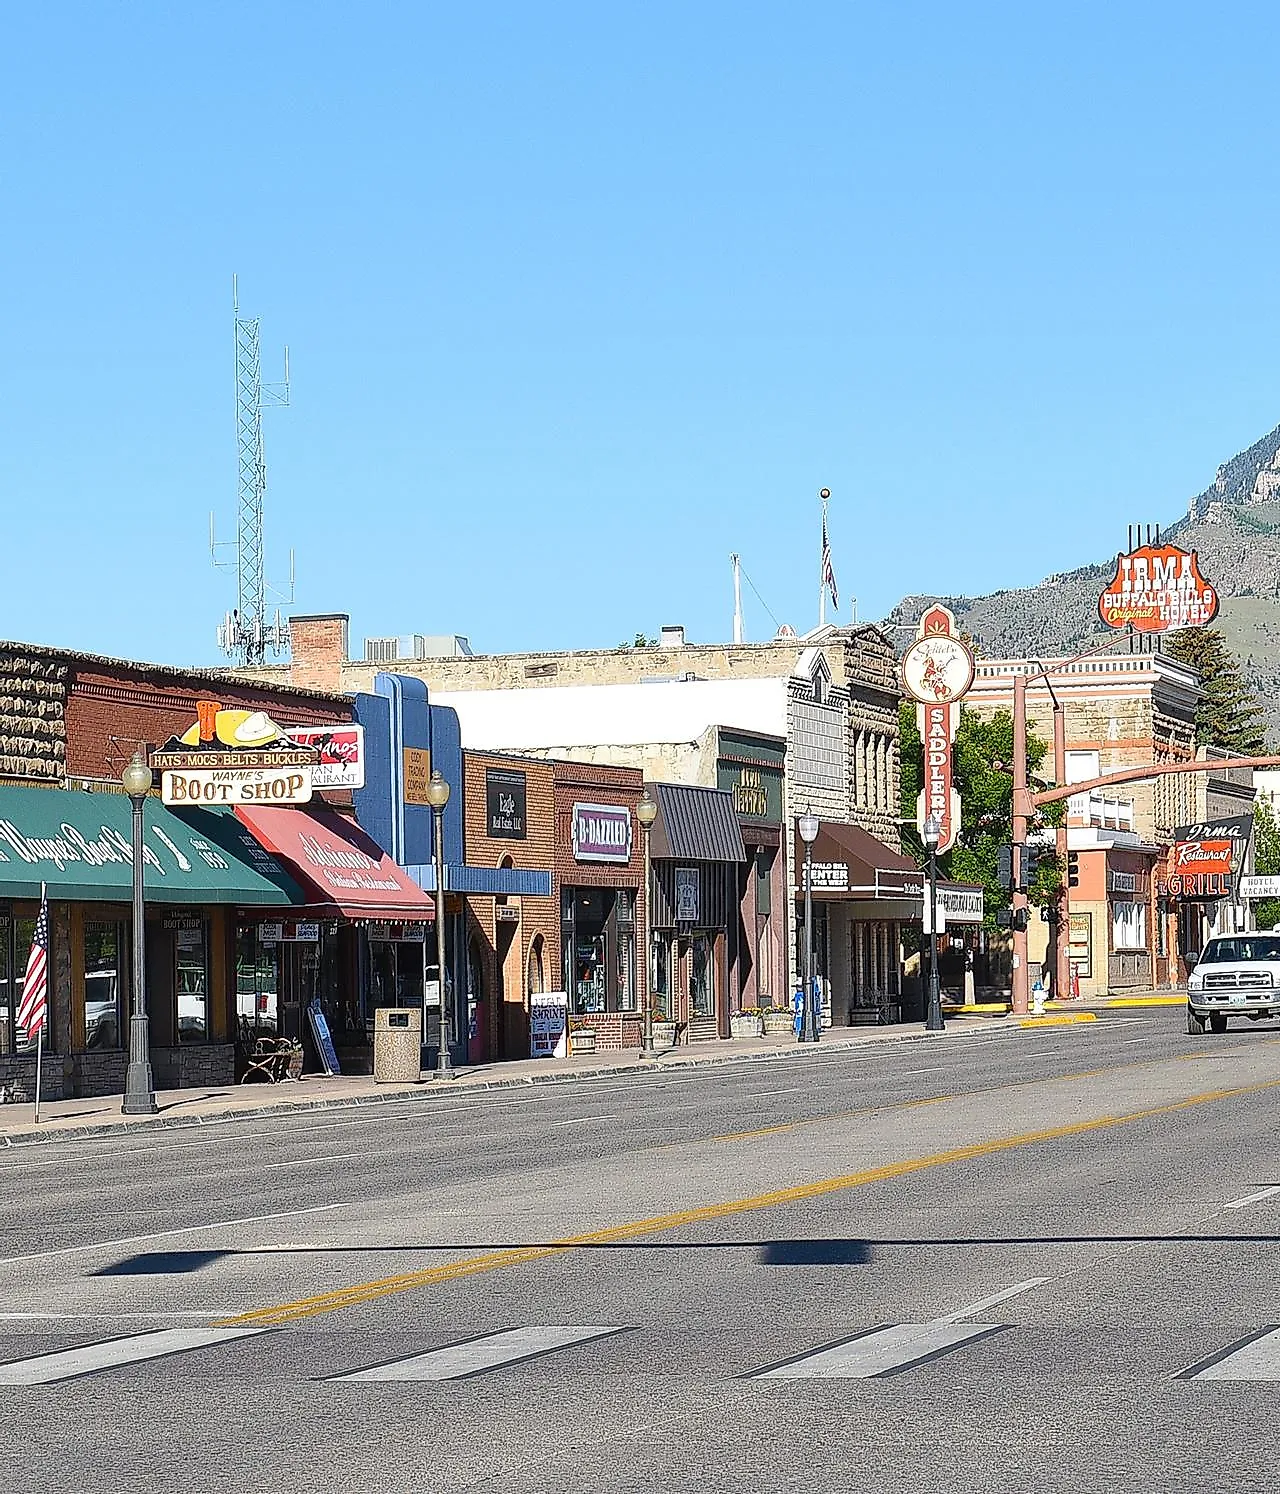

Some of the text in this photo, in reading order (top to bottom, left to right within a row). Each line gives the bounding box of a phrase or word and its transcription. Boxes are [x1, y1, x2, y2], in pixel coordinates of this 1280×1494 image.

[1121, 556, 1196, 592] IRMA
[1104, 589, 1166, 608] BUFFALO
[1107, 605, 1210, 622] Original HOTEL
[154, 752, 312, 766] HATS MOCS BELTS BUCKLES
[928, 708, 947, 823] SADDLERY
[212, 771, 264, 782] WAYNE'S
[311, 774, 357, 784] AURANT
[170, 773, 304, 800] BOOT SHOP
[498, 793, 515, 817] Eagle
[1185, 824, 1243, 841] Irma
[1177, 842, 1231, 866] Restaurant
[833, 862, 849, 870] BILL
[1167, 873, 1230, 896] GRILL
[1247, 878, 1275, 886] HOTEL
[1243, 887, 1279, 895] VACANCY
[163, 918, 201, 929] BOOT SHOP
[531, 1008, 565, 1020] SHRINE
